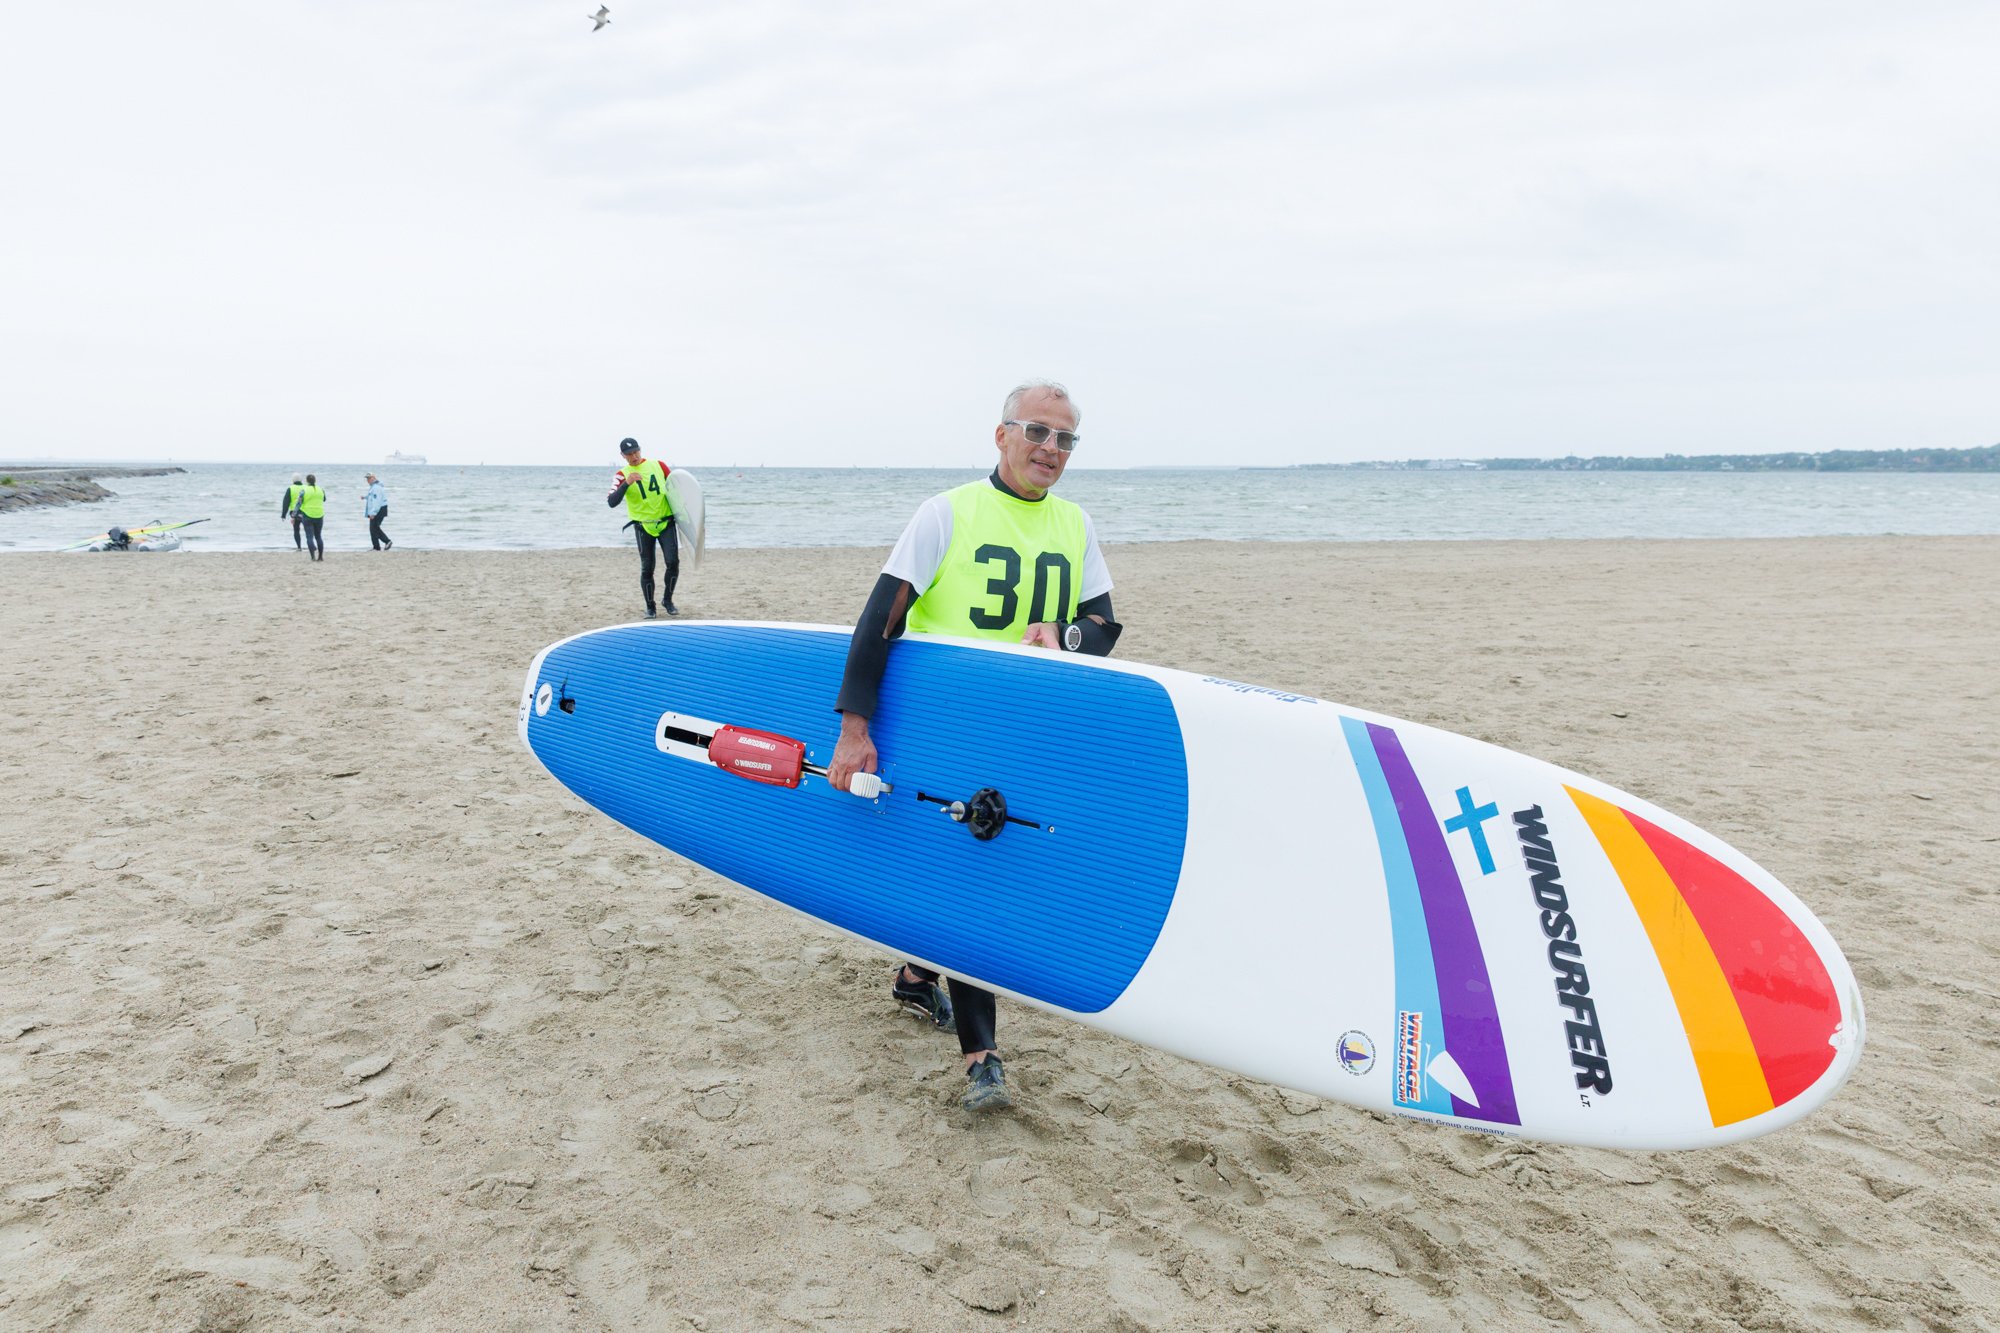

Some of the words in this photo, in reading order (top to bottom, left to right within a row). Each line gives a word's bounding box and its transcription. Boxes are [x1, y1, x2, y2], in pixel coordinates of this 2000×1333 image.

[635, 473, 661, 500] 14
[969, 543, 1071, 631] 30
[739, 760, 772, 771] WINDSURFER
[1510, 803, 1613, 1097] WINDSURFER
[1398, 1012, 1407, 1102] WINDSURF.COM
[1405, 1013, 1420, 1101] VINTAGE
[1398, 1112, 1434, 1125] Grimaldi
[1435, 1119, 1462, 1130] Group
[1464, 1125, 1506, 1136] company
